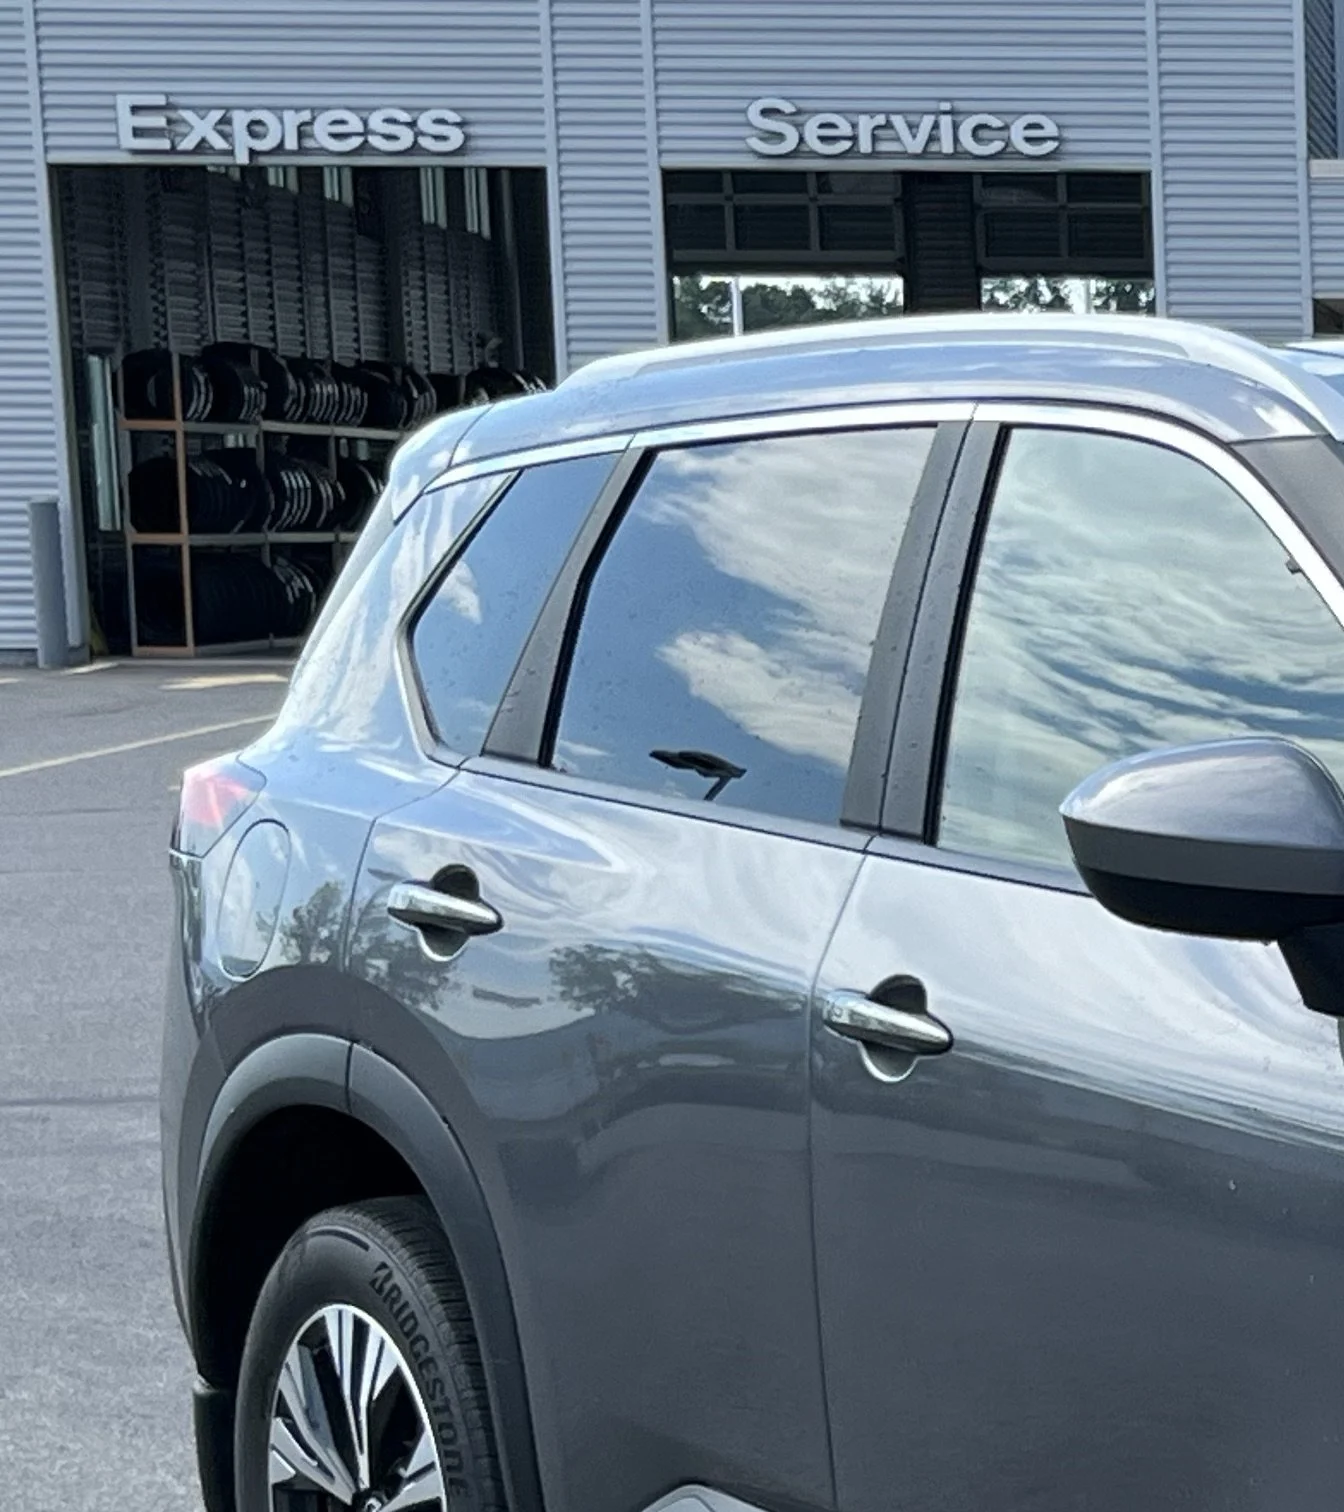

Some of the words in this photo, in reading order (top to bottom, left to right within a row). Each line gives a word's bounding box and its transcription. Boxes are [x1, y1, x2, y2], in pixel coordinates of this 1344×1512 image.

[115, 93, 465, 165] Express
[746, 98, 1060, 156] Service
[369, 1261, 468, 1498] BRIDGESTONE
